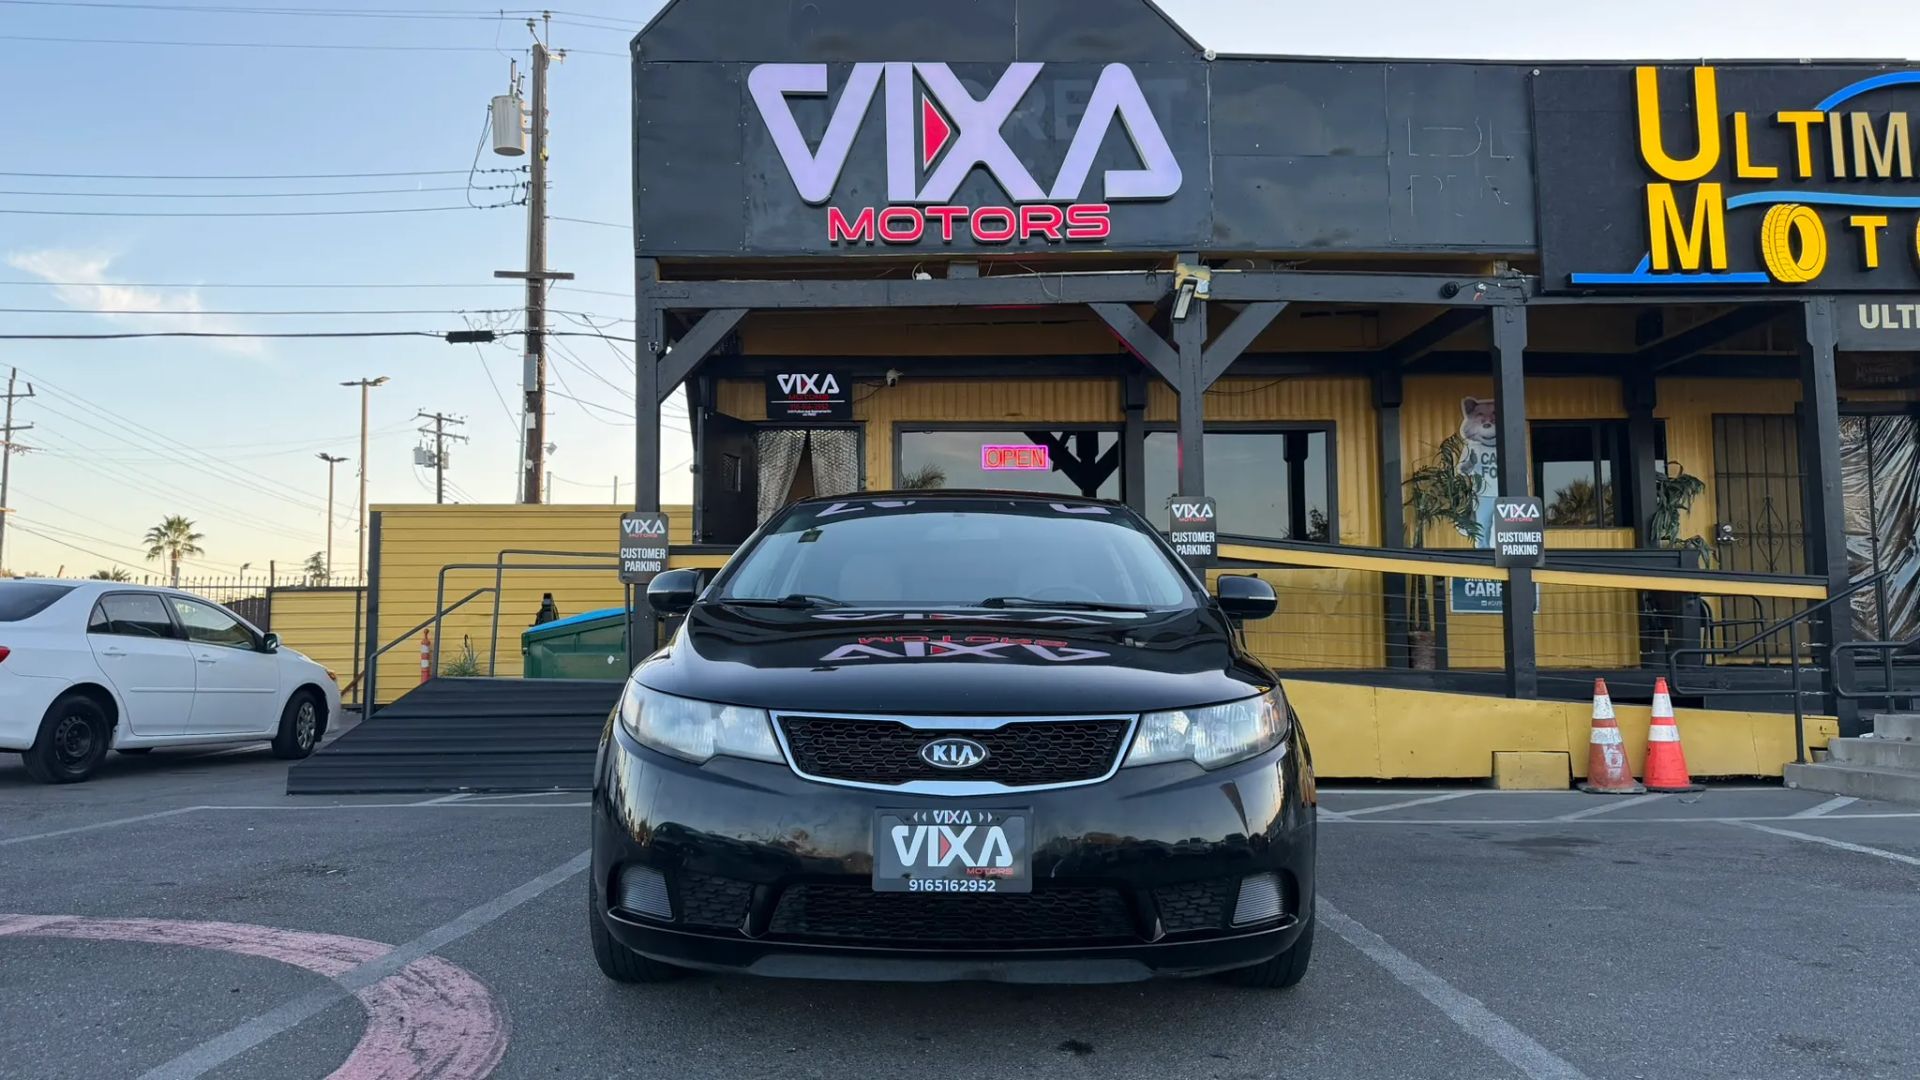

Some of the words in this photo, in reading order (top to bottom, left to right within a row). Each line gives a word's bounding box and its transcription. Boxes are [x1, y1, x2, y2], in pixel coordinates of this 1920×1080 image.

[747, 61, 1183, 202] VIXA
[827, 203, 1111, 245] MOTORS
[1646, 182, 1920, 283] MOT
[776, 373, 840, 395] VIXA
[986, 447, 1044, 467] OPEN
[1171, 503, 1214, 518] VIXA
[1496, 503, 1540, 518] VIXA
[622, 519, 666, 534] VIXA
[1171, 531, 1216, 543] CUSTOMER
[1497, 531, 1542, 543] CUSTOMER
[621, 547, 666, 559] CUSTOMER
[1176, 544, 1212, 556] PARKING
[1502, 544, 1538, 556] PARKING
[624, 560, 661, 572] PARKING
[933, 745, 977, 763] KIA
[933, 810, 972, 824] VIXA
[891, 825, 1013, 867] VIXA
[966, 867, 1013, 875] MOTORS
[908, 879, 996, 892] 9165162952
